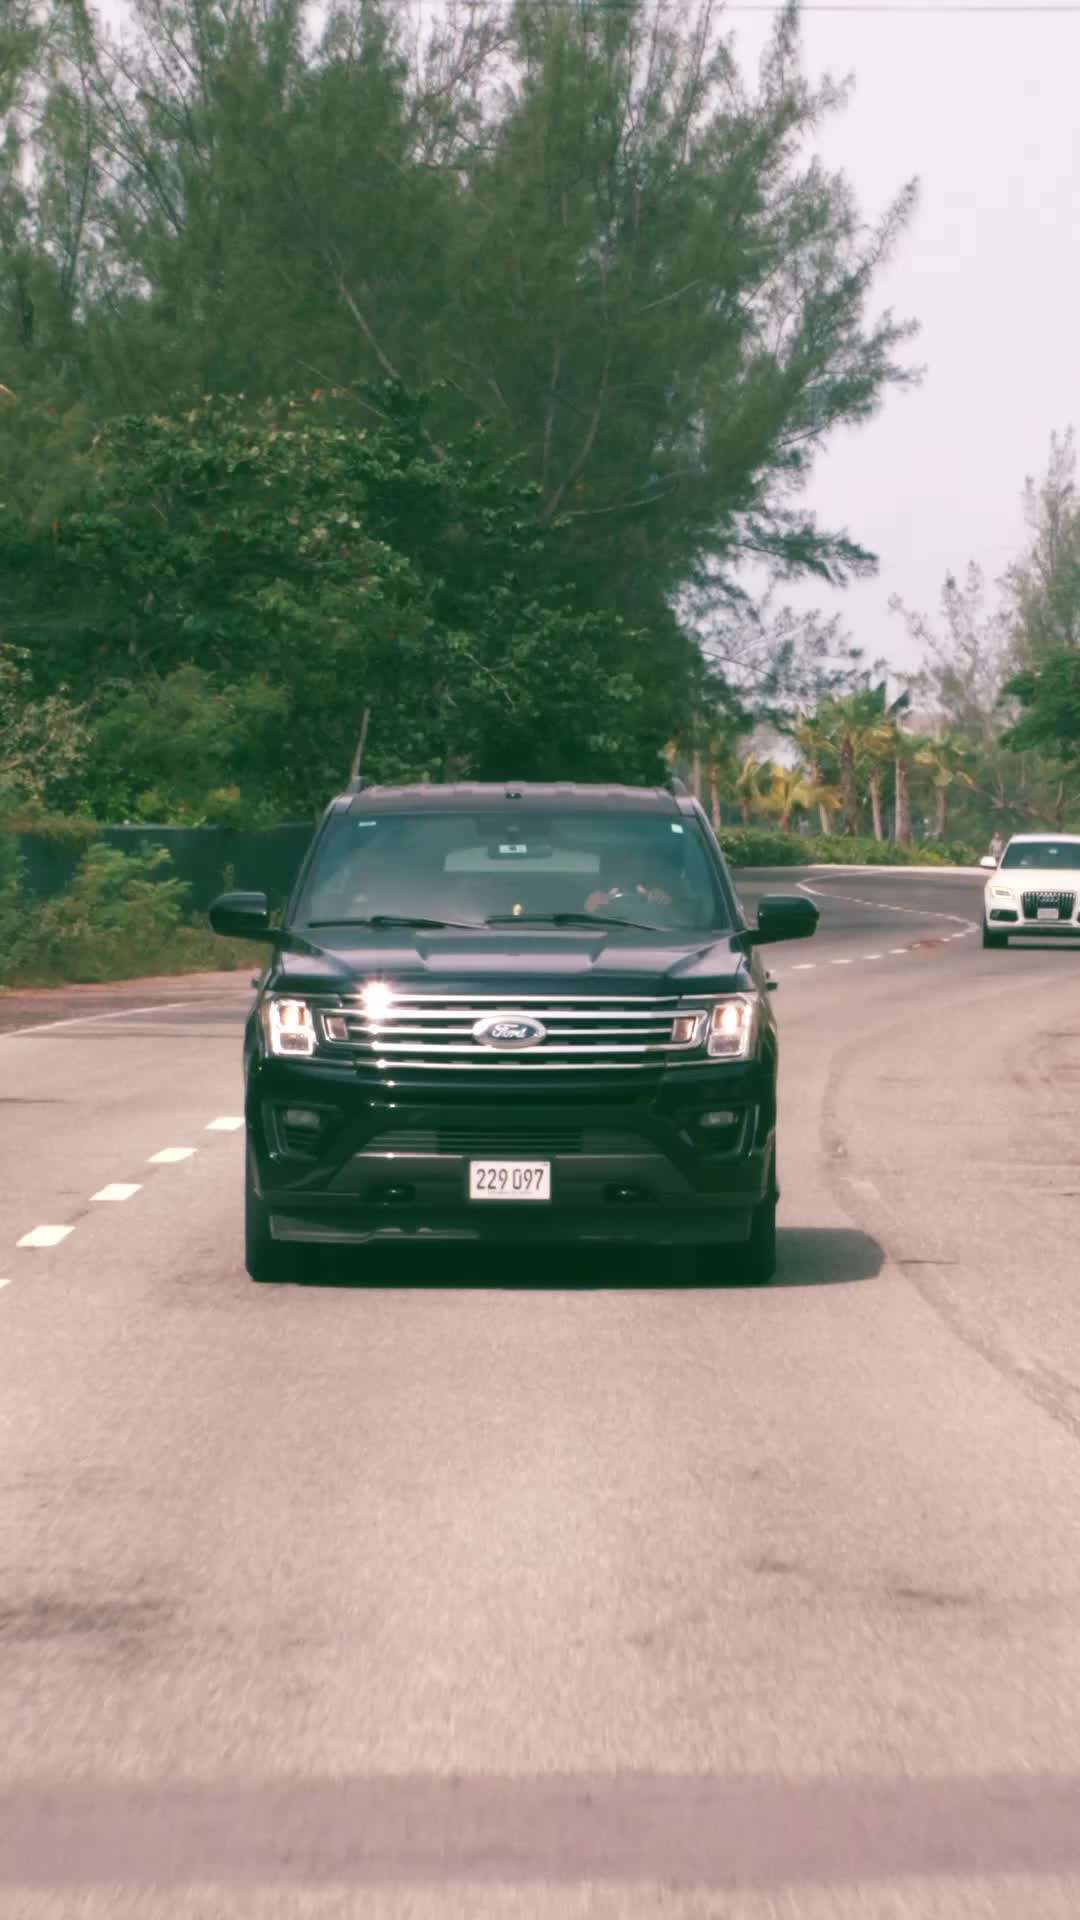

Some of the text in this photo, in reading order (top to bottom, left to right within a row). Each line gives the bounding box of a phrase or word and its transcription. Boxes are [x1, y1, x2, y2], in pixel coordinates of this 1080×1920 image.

[491, 1023, 528, 1039] Ford
[476, 1168, 544, 1190] 229 097
